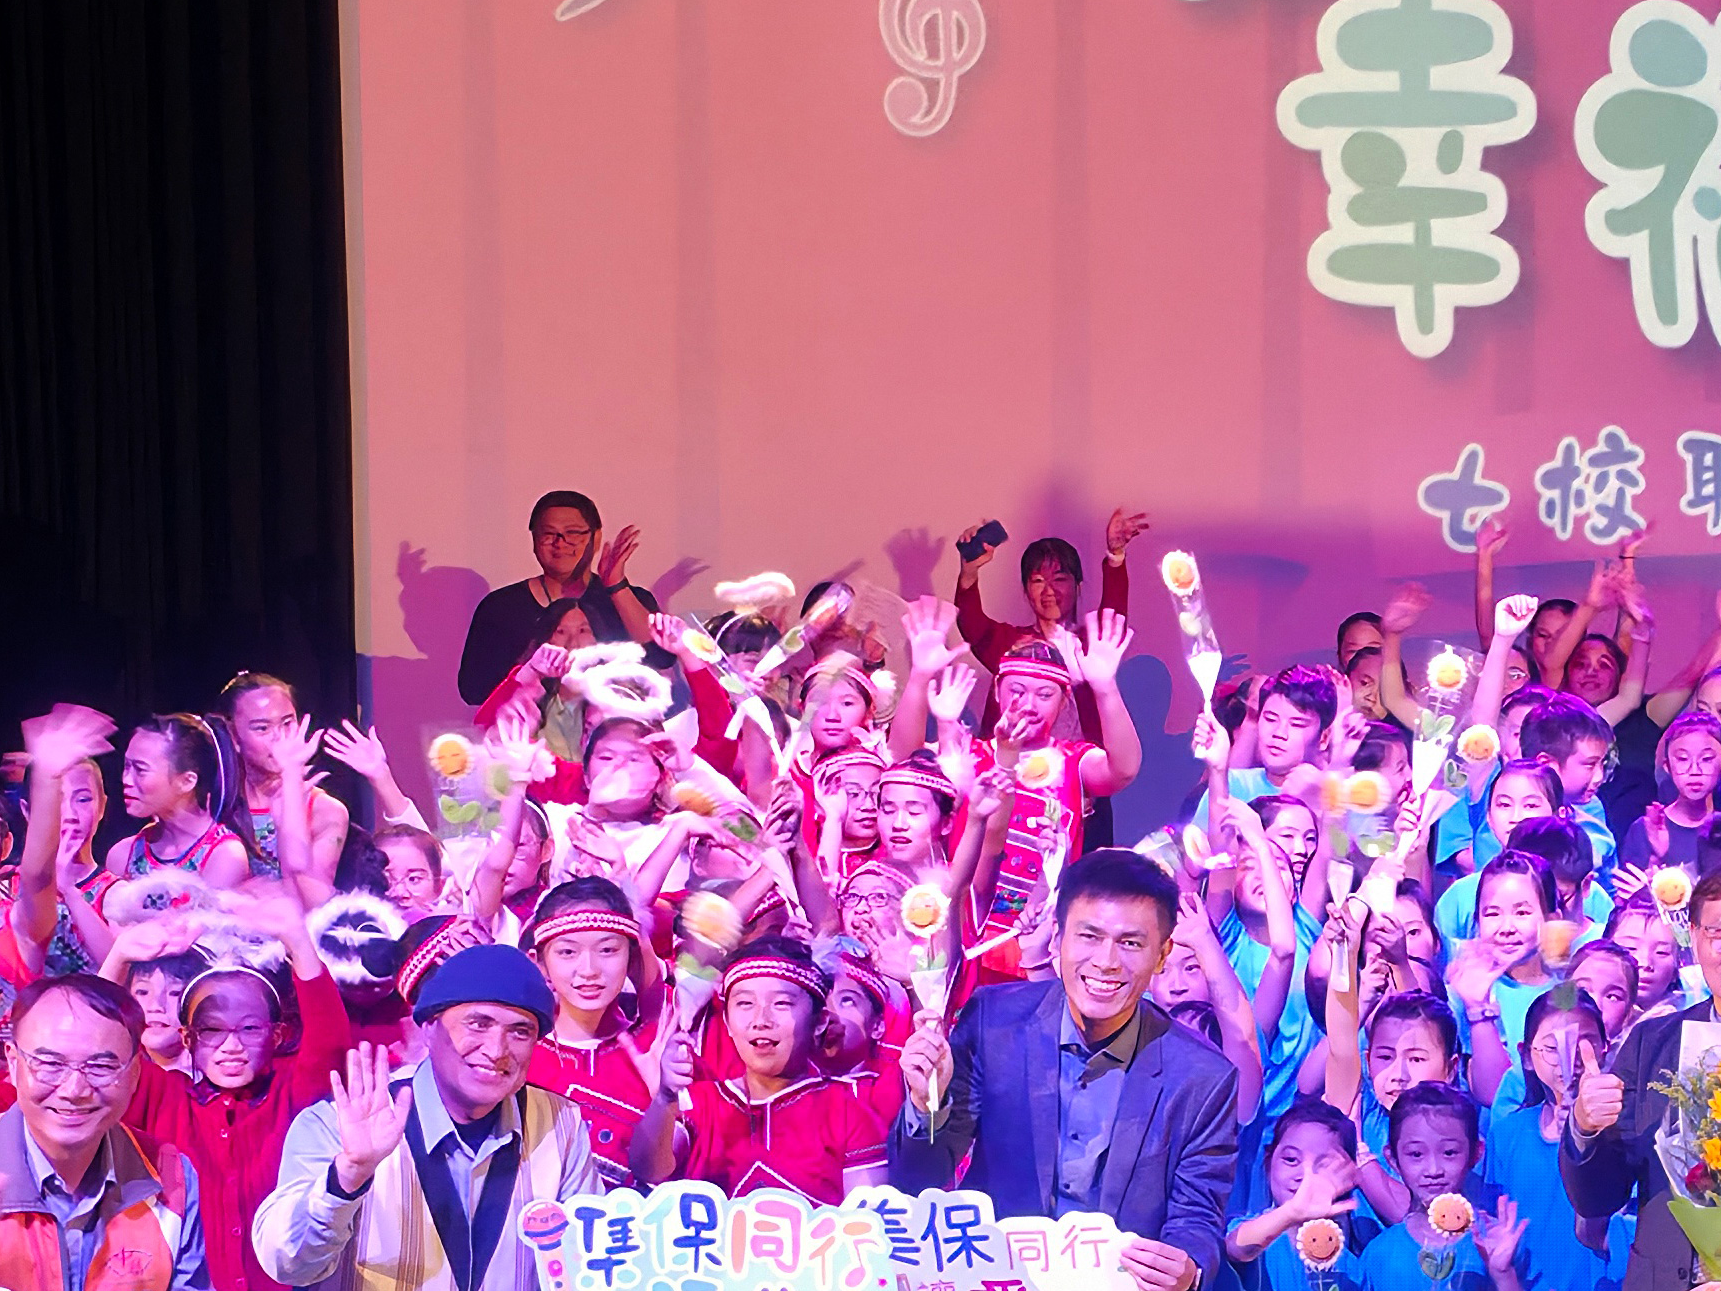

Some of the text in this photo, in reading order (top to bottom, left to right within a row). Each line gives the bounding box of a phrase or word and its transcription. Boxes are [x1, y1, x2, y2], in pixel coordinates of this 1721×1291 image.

[575, 1193, 879, 1291] 集保同行
[855, 1199, 1107, 1274] 集保同行
